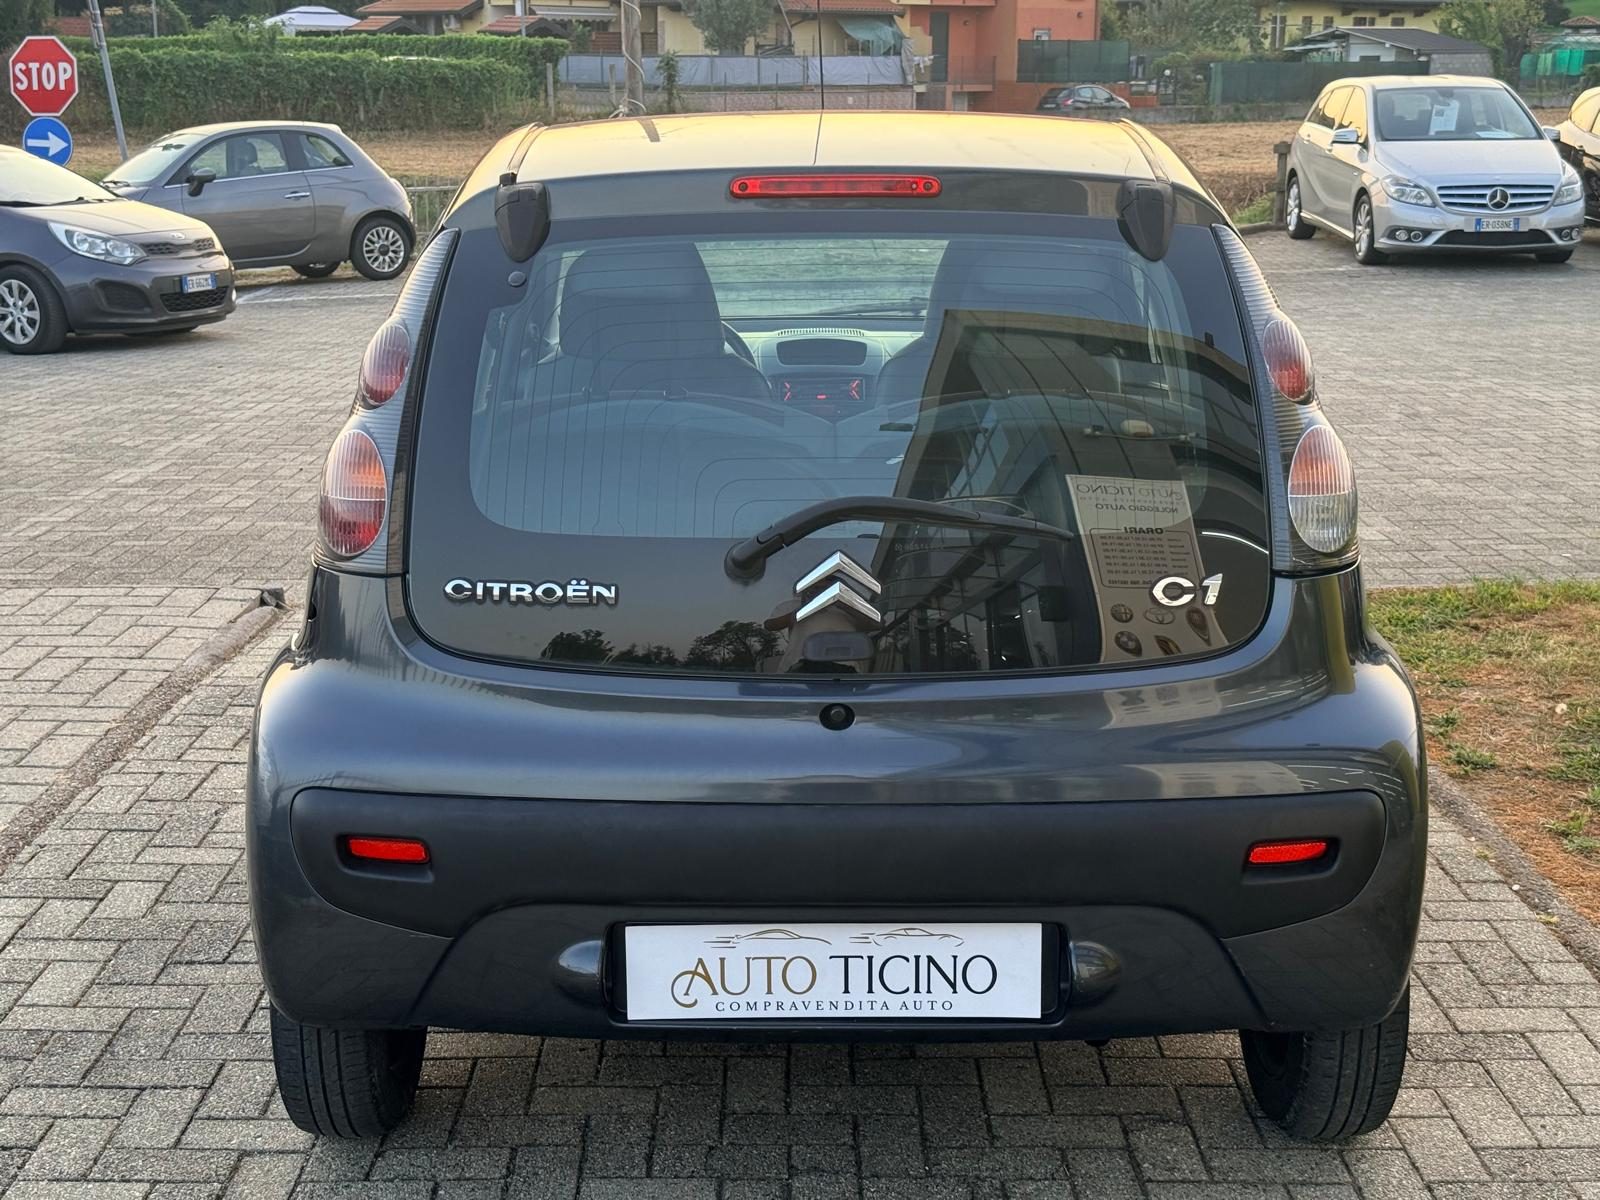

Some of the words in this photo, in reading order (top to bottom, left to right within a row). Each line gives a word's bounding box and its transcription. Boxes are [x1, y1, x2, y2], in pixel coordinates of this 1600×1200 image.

[14, 62, 73, 91] STOP
[444, 579, 616, 605] CITROËN
[1152, 573, 1224, 607] C1
[671, 955, 817, 1009] AUTO
[829, 954, 998, 995] TICINO
[715, 1000, 891, 1012] COMPRAVENDITA
[899, 1000, 954, 1011] AUTO
